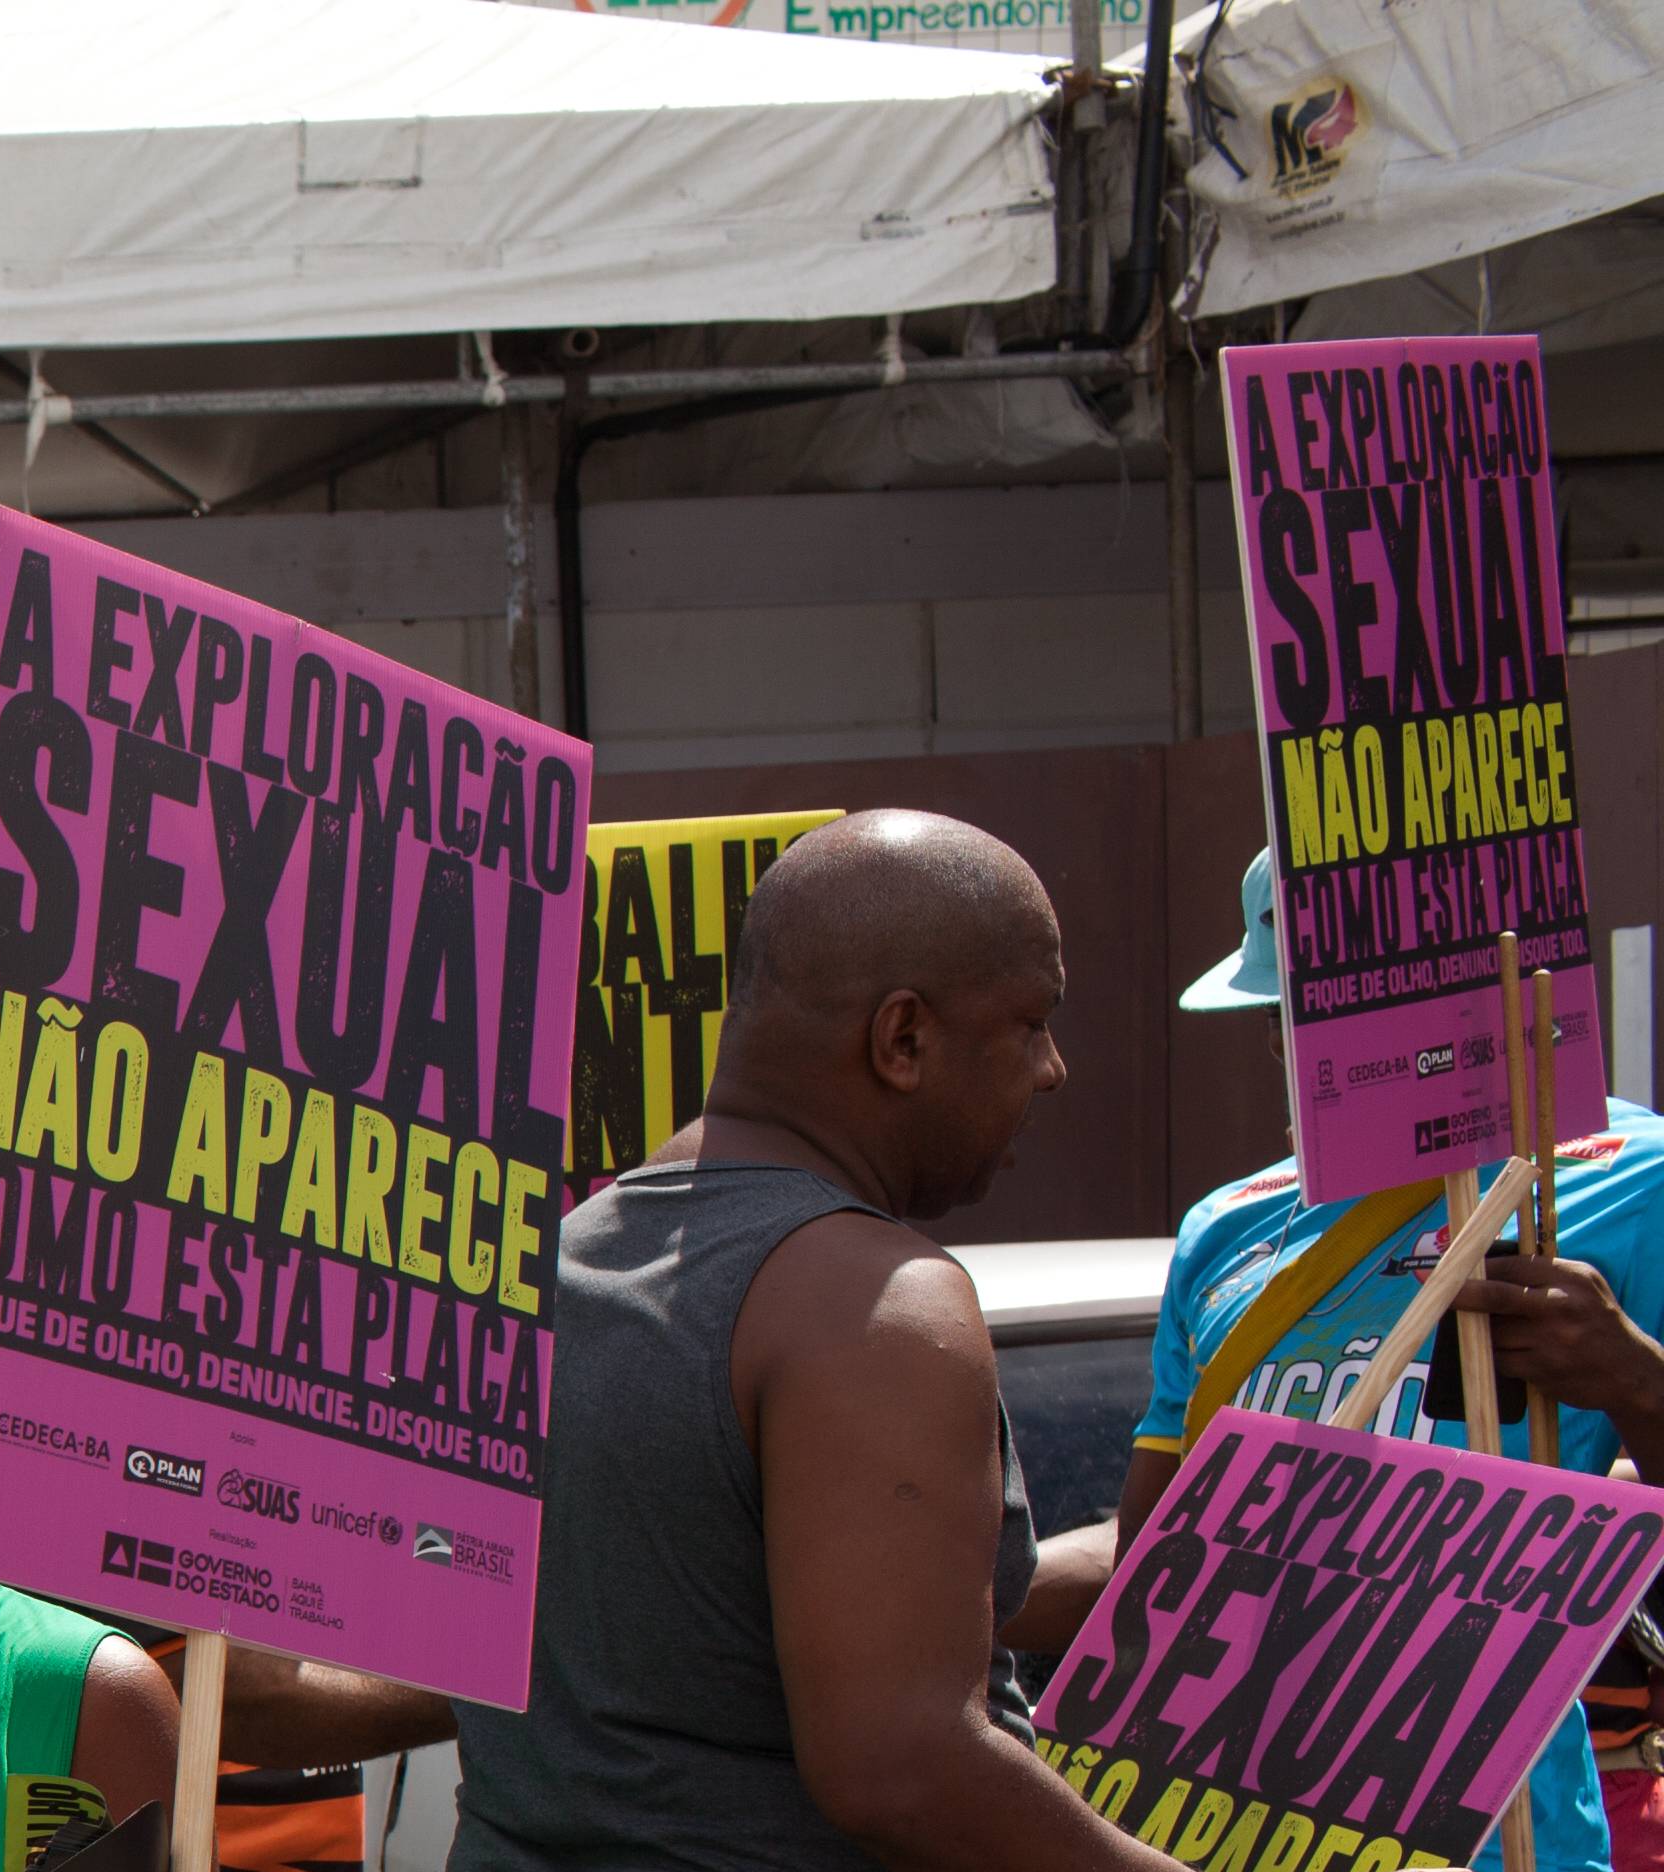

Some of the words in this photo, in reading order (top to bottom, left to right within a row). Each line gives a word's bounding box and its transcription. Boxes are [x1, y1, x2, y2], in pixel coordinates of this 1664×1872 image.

[1245, 374, 1285, 496] A
[1287, 359, 1542, 492] EXPLORAÇÃO
[1258, 476, 1567, 730] SEXUAL
[87, 574, 574, 896] EXPLORAÇÃO
[1281, 725, 1386, 869] NÃO
[1403, 702, 1572, 850] APARECE
[1284, 858, 1401, 970] COMO
[1414, 846, 1487, 950] ESTA
[1499, 831, 1586, 930] PLACA
[1302, 978, 1359, 1014] FIQUE
[1362, 972, 1384, 999] DE
[1388, 965, 1436, 995] OLHO,
[1563, 929, 1587, 956] 100.
[1431, 1049, 1453, 1067] PLAN
[166, 1049, 547, 1317] APARECE
[163, 1213, 318, 1368] ESTA
[351, 1268, 548, 1434] PLACA
[53, 1314, 92, 1359] DE
[94, 1325, 192, 1389] OLHO,
[197, 1354, 361, 1431] DENUNCIE.
[366, 1401, 475, 1463] DISQUE
[478, 1431, 535, 1477] 100.
[158, 1457, 201, 1485] PLAN
[240, 1476, 300, 1526] SUAS
[310, 1497, 378, 1540] unicef
[1158, 1433, 1245, 1532] A
[1213, 1441, 1664, 1627] EXPLORAÇÃO
[181, 1551, 271, 1590] GOVERNO
[181, 1572, 208, 1597] DO
[211, 1580, 280, 1613] ESTADO
[453, 1543, 514, 1578] BRASIL
[1054, 1527, 1568, 1840] SEXUAL
